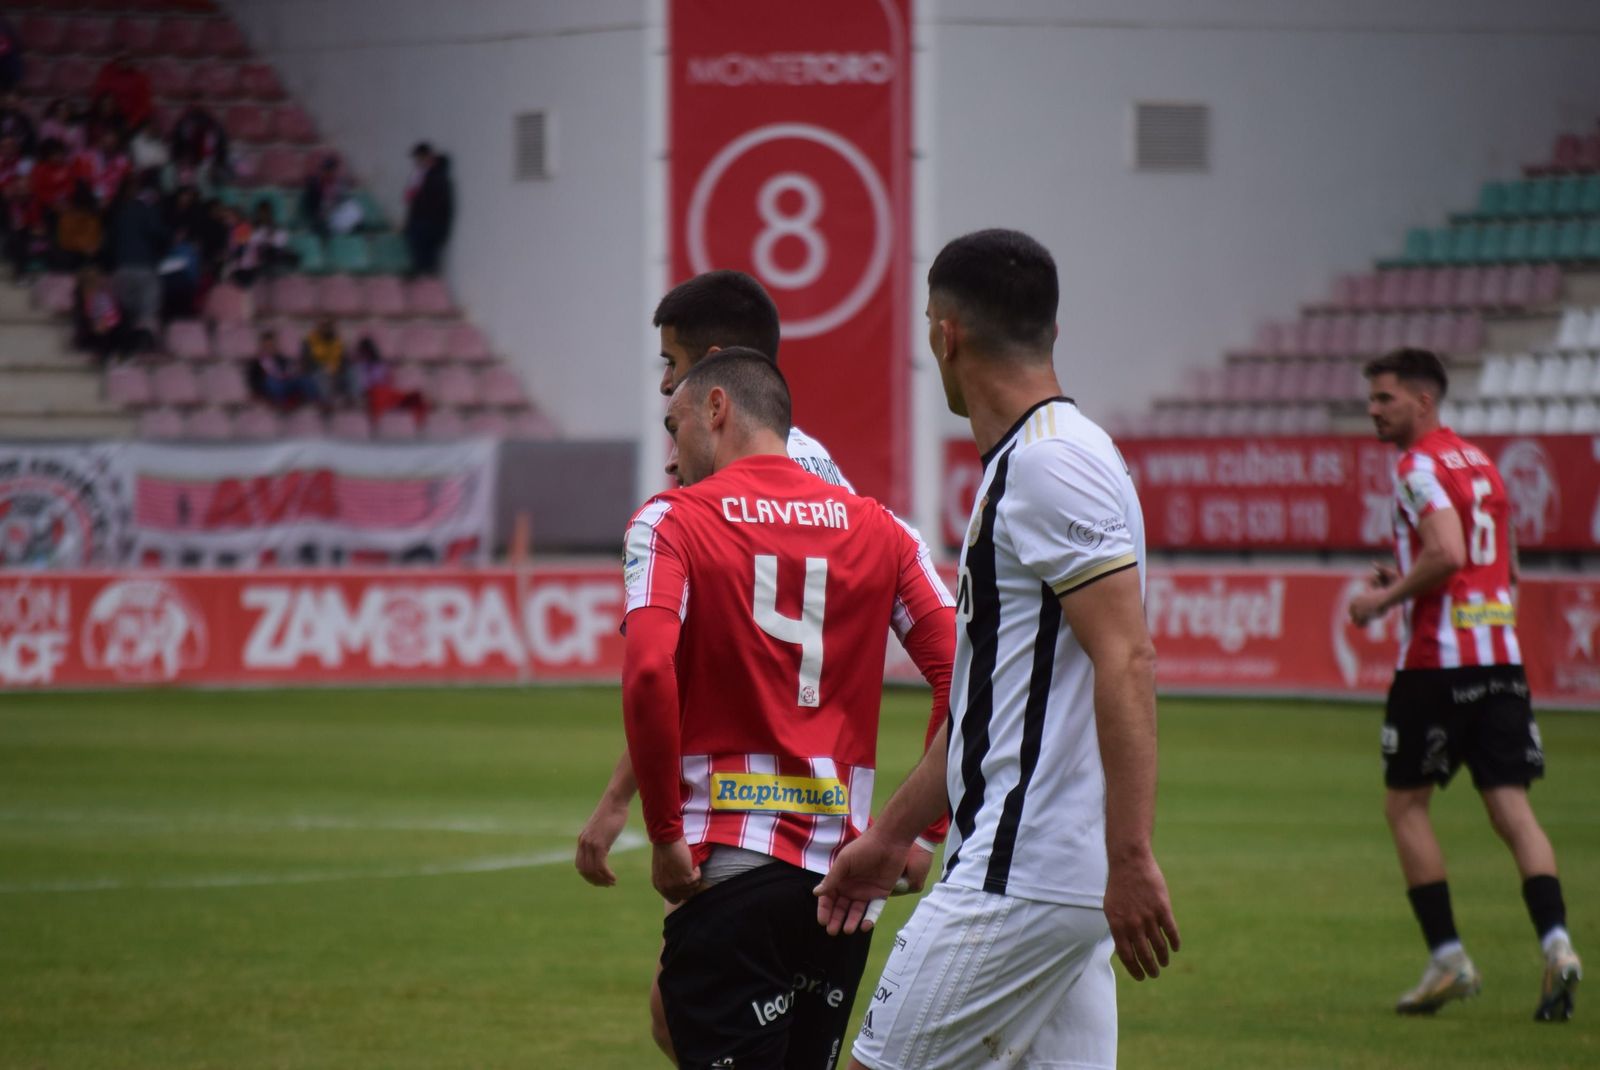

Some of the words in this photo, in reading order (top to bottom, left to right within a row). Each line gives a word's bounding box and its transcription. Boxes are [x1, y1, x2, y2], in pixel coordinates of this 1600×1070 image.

[753, 172, 828, 290] 8
[722, 497, 849, 530] CLAVERÍA
[1471, 477, 1497, 566] 6
[752, 554, 828, 708] 4
